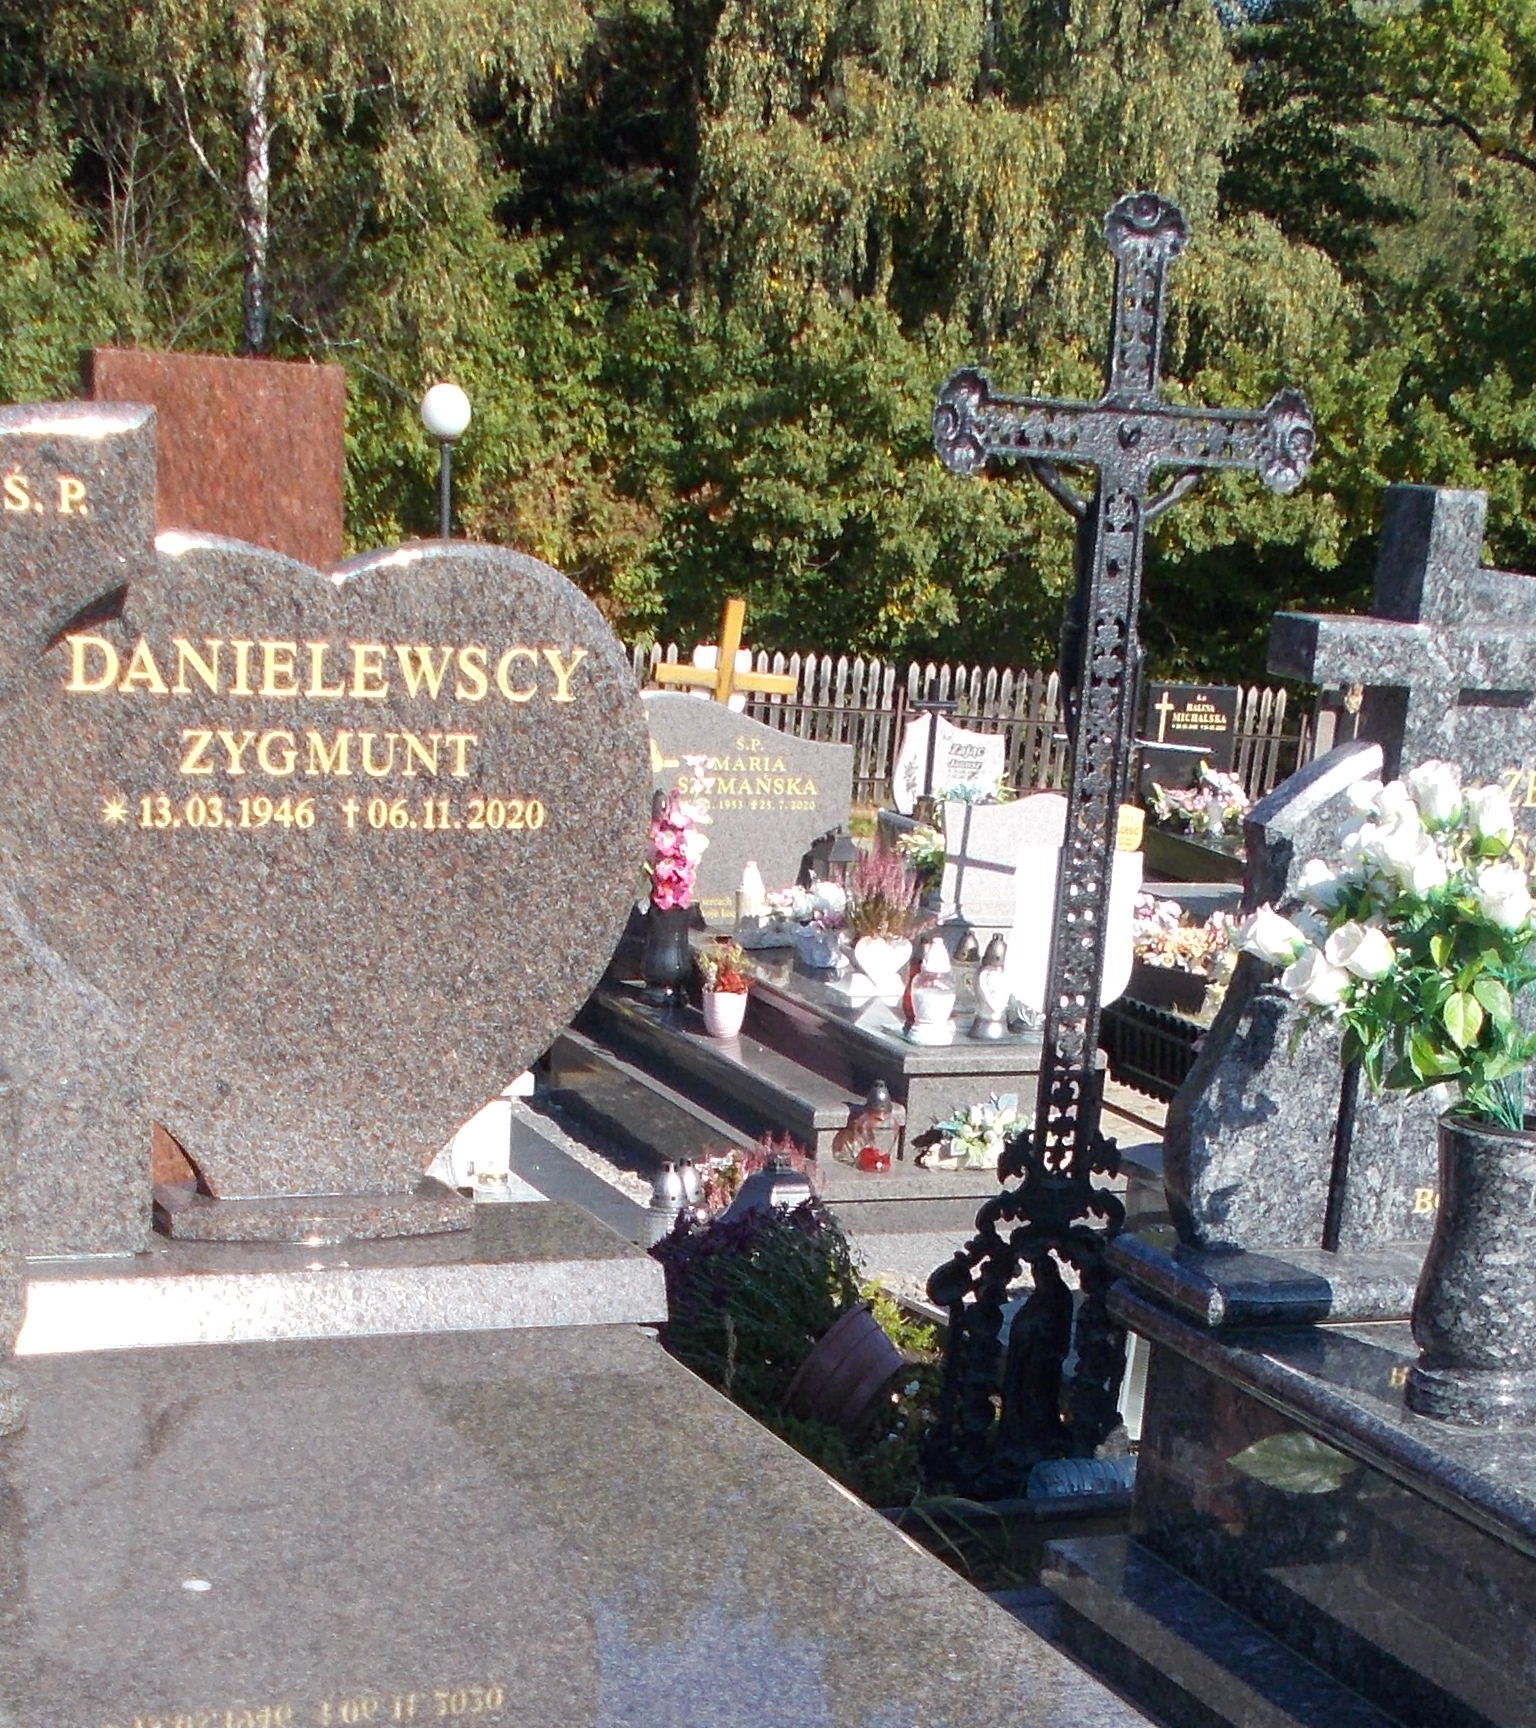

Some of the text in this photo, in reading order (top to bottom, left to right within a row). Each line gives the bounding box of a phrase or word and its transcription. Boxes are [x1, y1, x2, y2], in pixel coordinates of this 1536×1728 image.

[66, 634, 588, 703] DANIELEWSCY
[180, 729, 478, 778] ZYGMUNT
[714, 755, 787, 773] MARIA
[139, 796, 545, 831] 13.03.1946 06.11.2020
